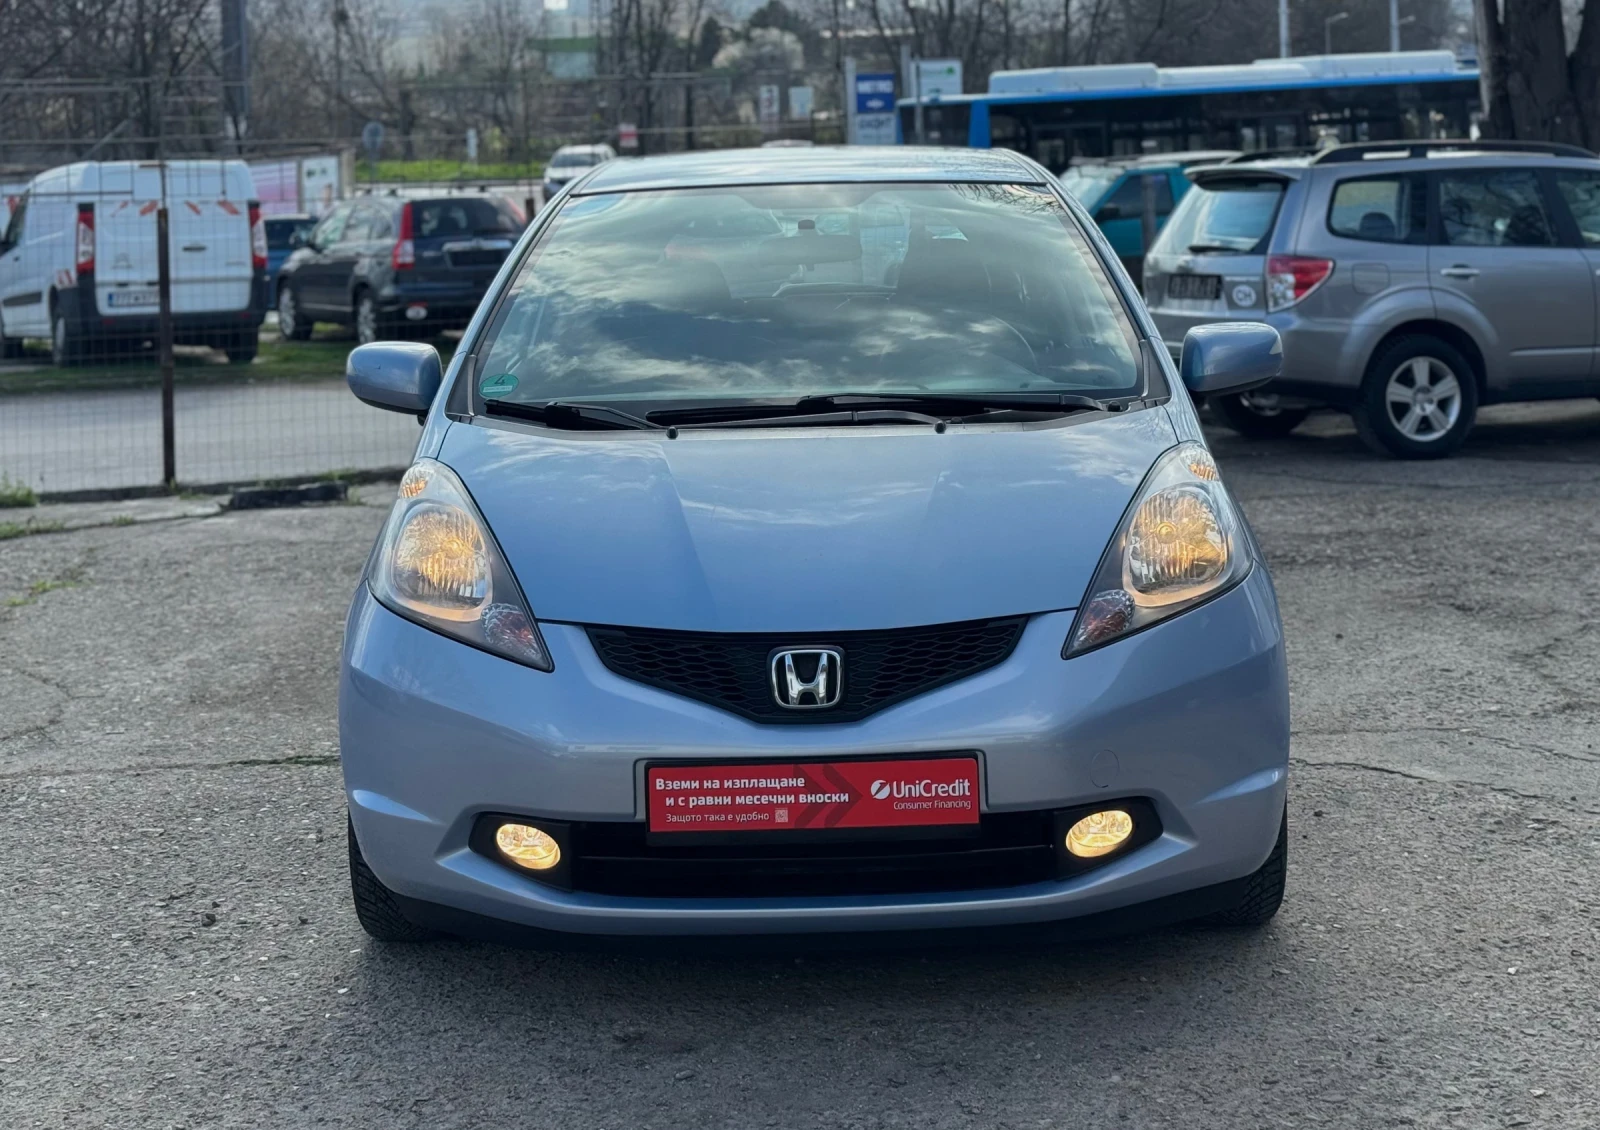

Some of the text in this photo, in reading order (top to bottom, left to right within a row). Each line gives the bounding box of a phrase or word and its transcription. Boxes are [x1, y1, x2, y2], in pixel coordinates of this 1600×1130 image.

[494, 375, 506, 386] 4
[655, 777, 806, 790] Вземи на изплащане
[893, 778, 971, 798] UniCredit
[665, 791, 849, 809] и с равни месечни вноски
[893, 799, 971, 810] Consumer Financing
[665, 811, 770, 823] Защото така е удобно
